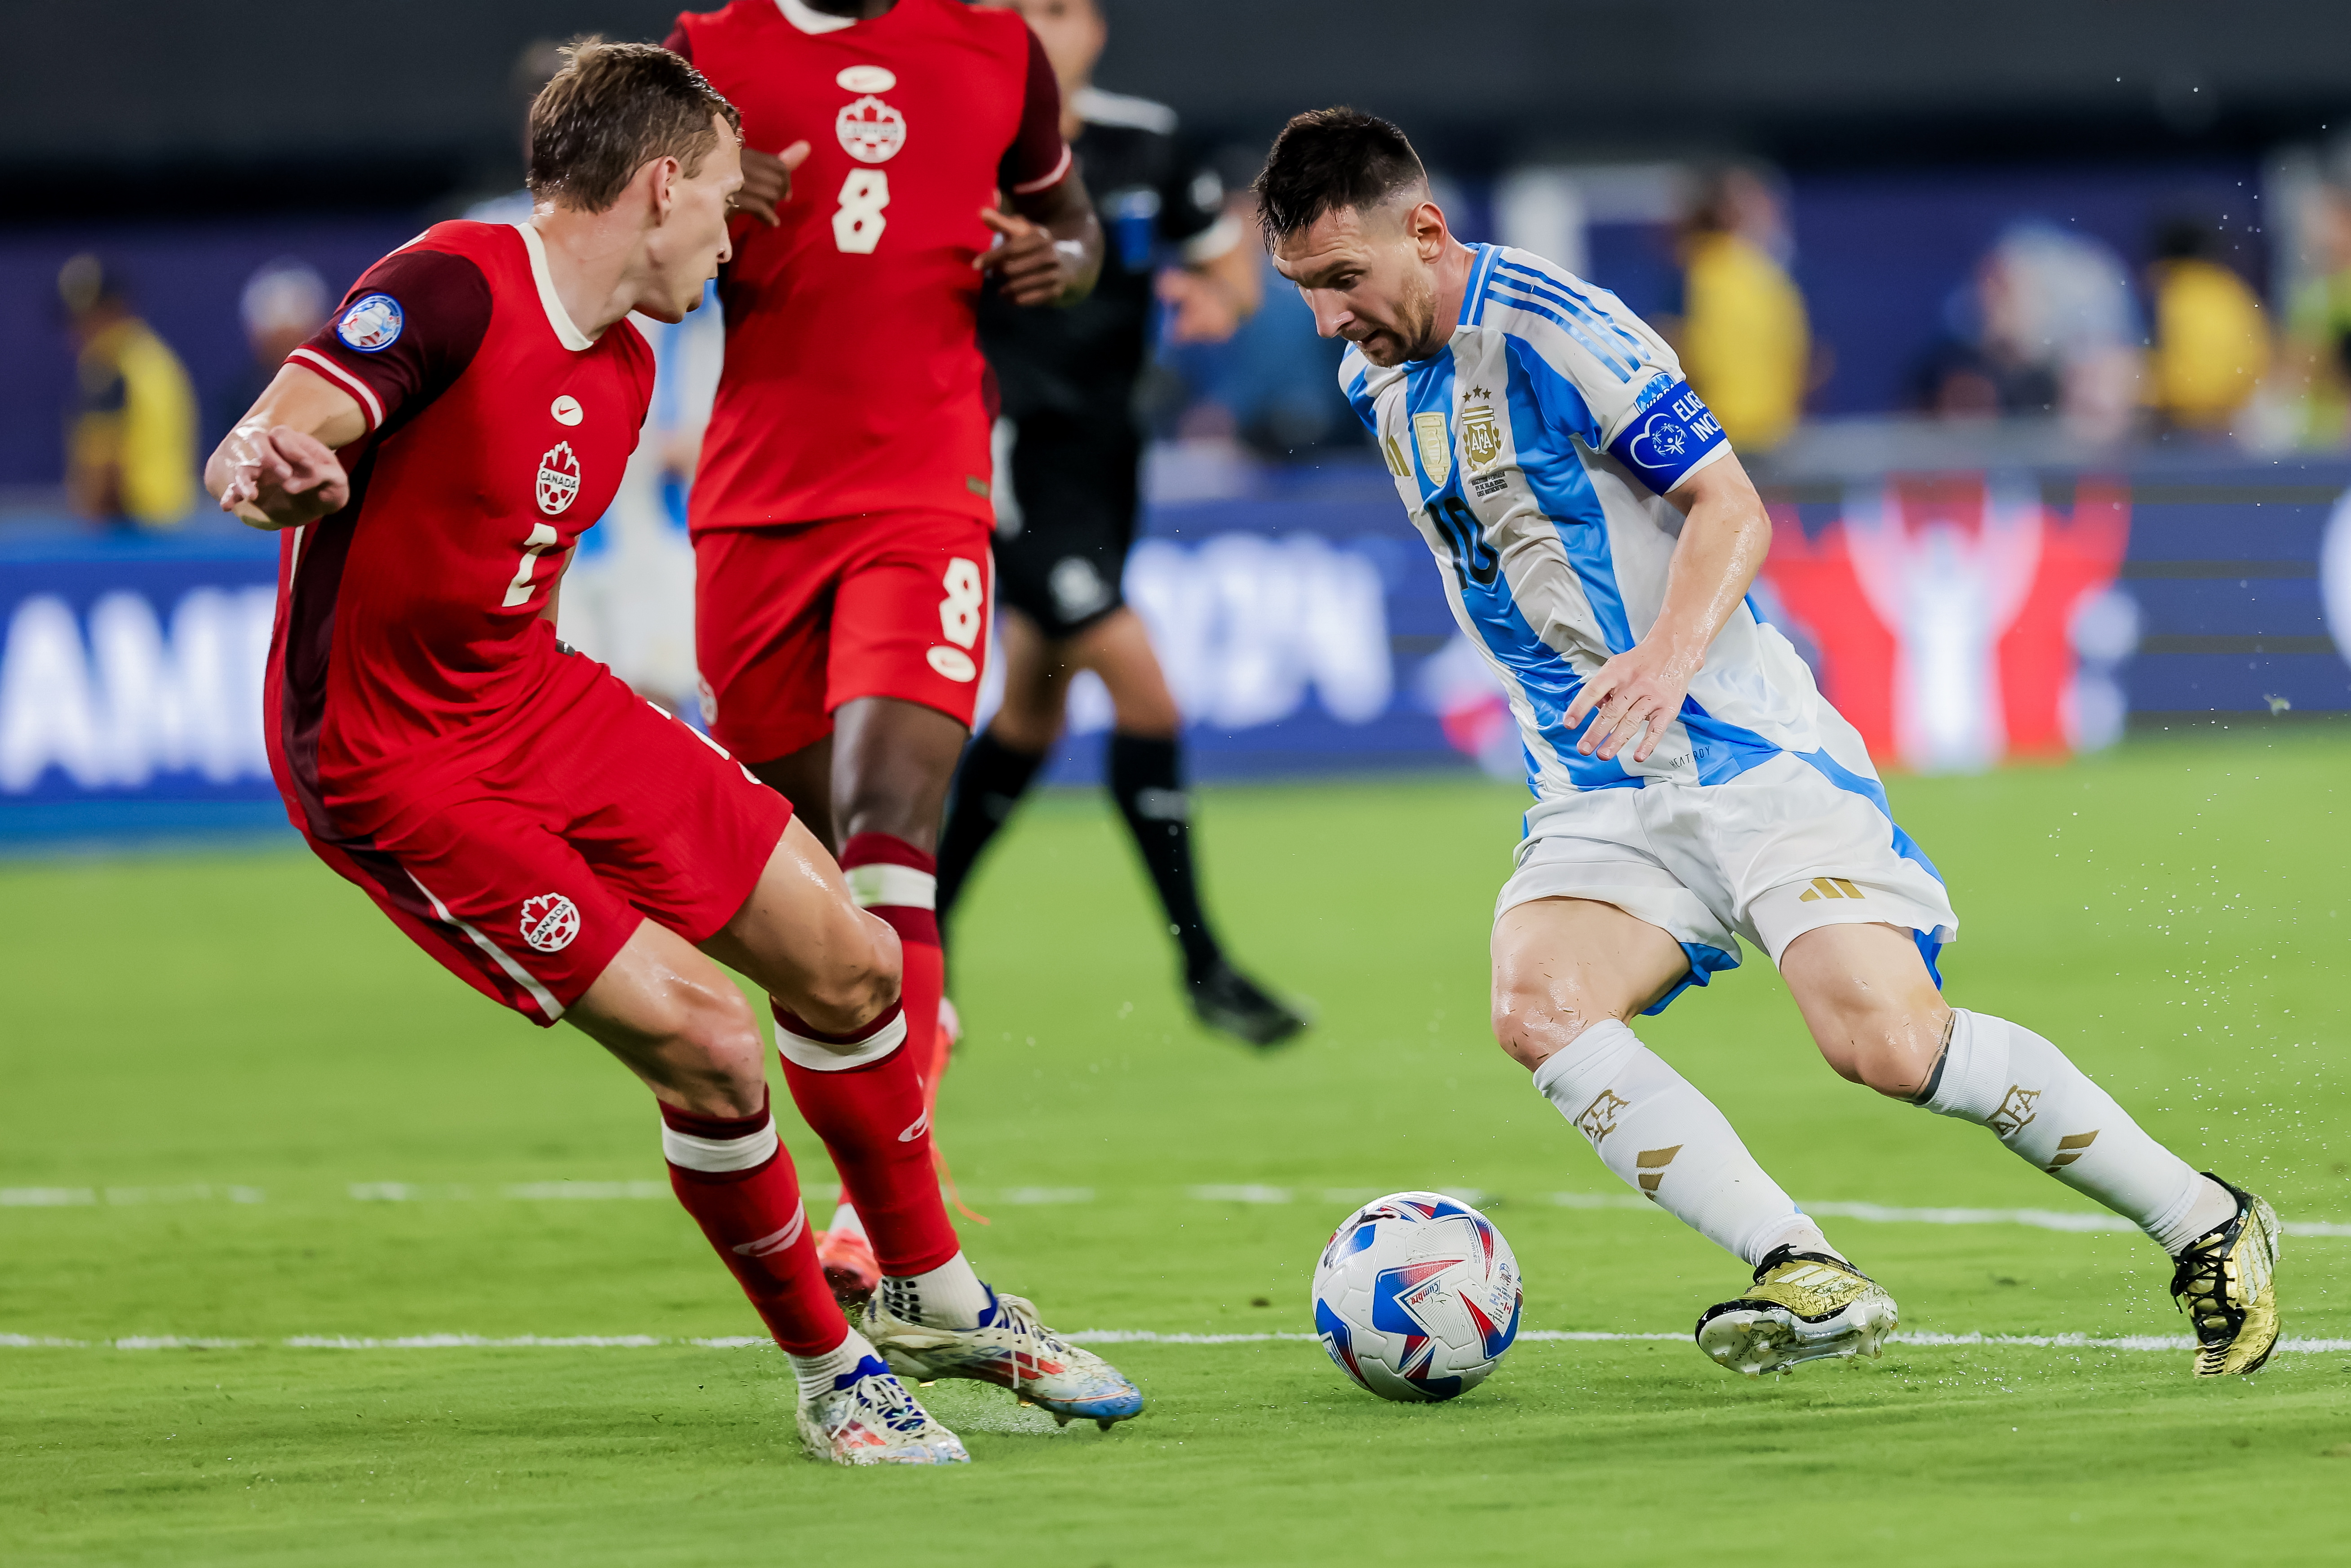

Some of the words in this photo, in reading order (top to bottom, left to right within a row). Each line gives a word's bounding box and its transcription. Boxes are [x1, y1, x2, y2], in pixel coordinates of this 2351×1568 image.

[832, 167, 890, 254] 8
[541, 471, 577, 489] CANADA
[1471, 424, 1493, 455] AFA
[501, 522, 558, 607] 2
[1427, 496, 1499, 590] 10
[939, 557, 983, 650] 8
[531, 904, 569, 944] CANADA
